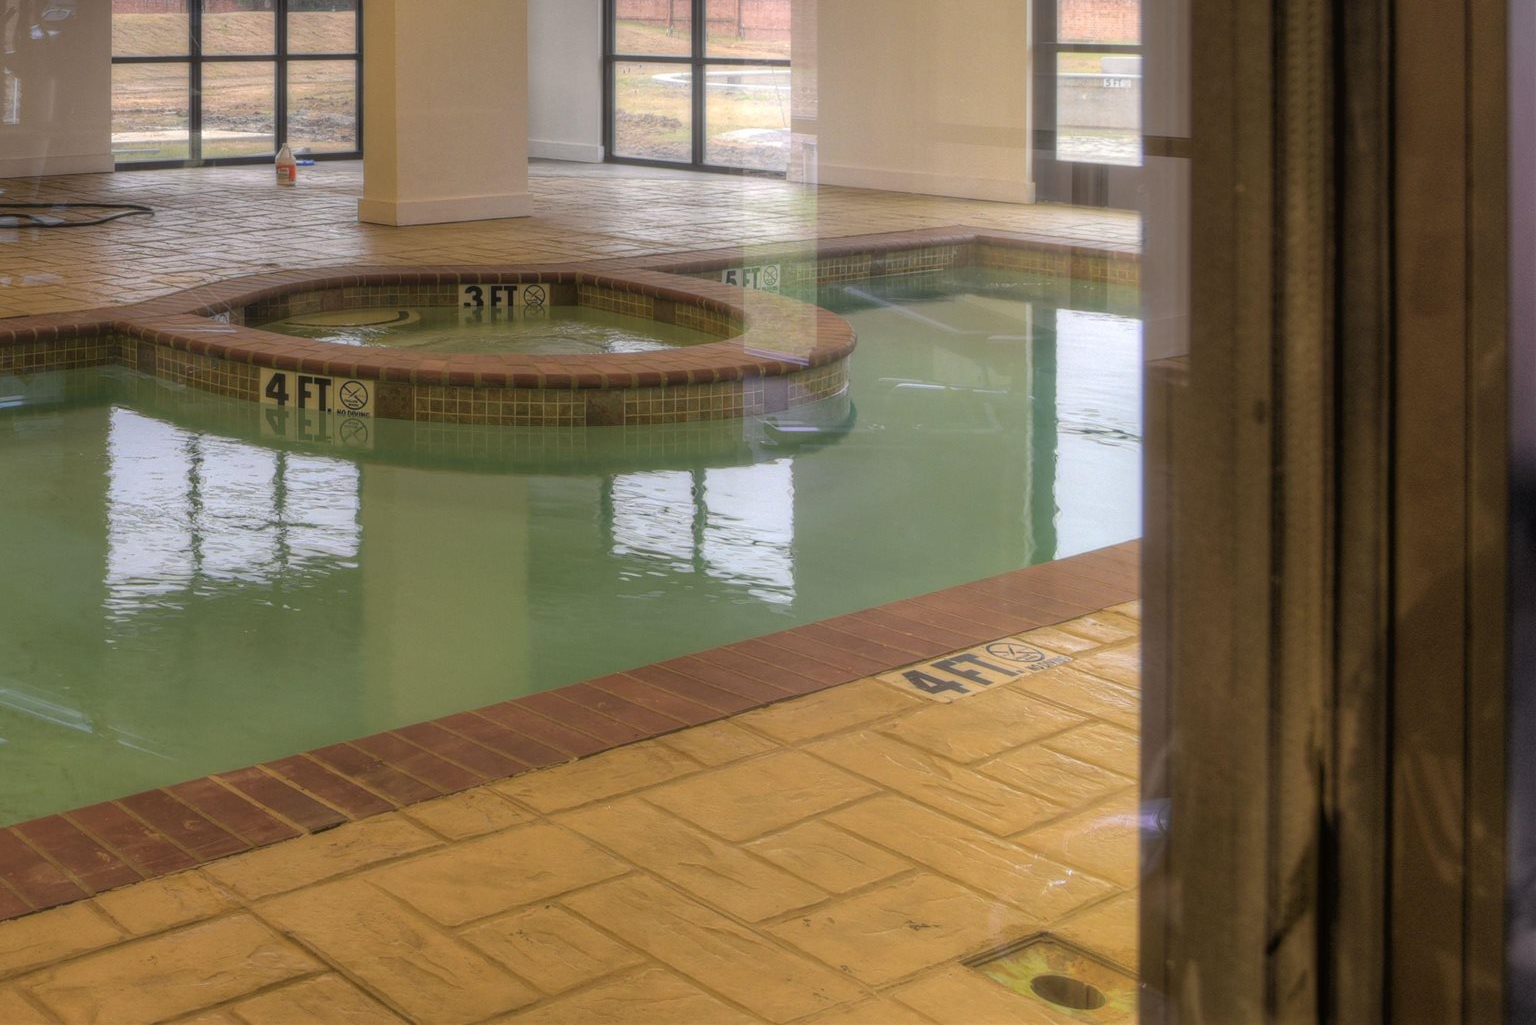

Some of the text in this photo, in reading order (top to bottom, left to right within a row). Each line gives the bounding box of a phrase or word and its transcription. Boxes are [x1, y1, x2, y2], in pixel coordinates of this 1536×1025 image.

[725, 270, 737, 286] 5
[464, 285, 518, 306] 3 FT
[265, 372, 289, 406] 4
[901, 669, 972, 695] 4
